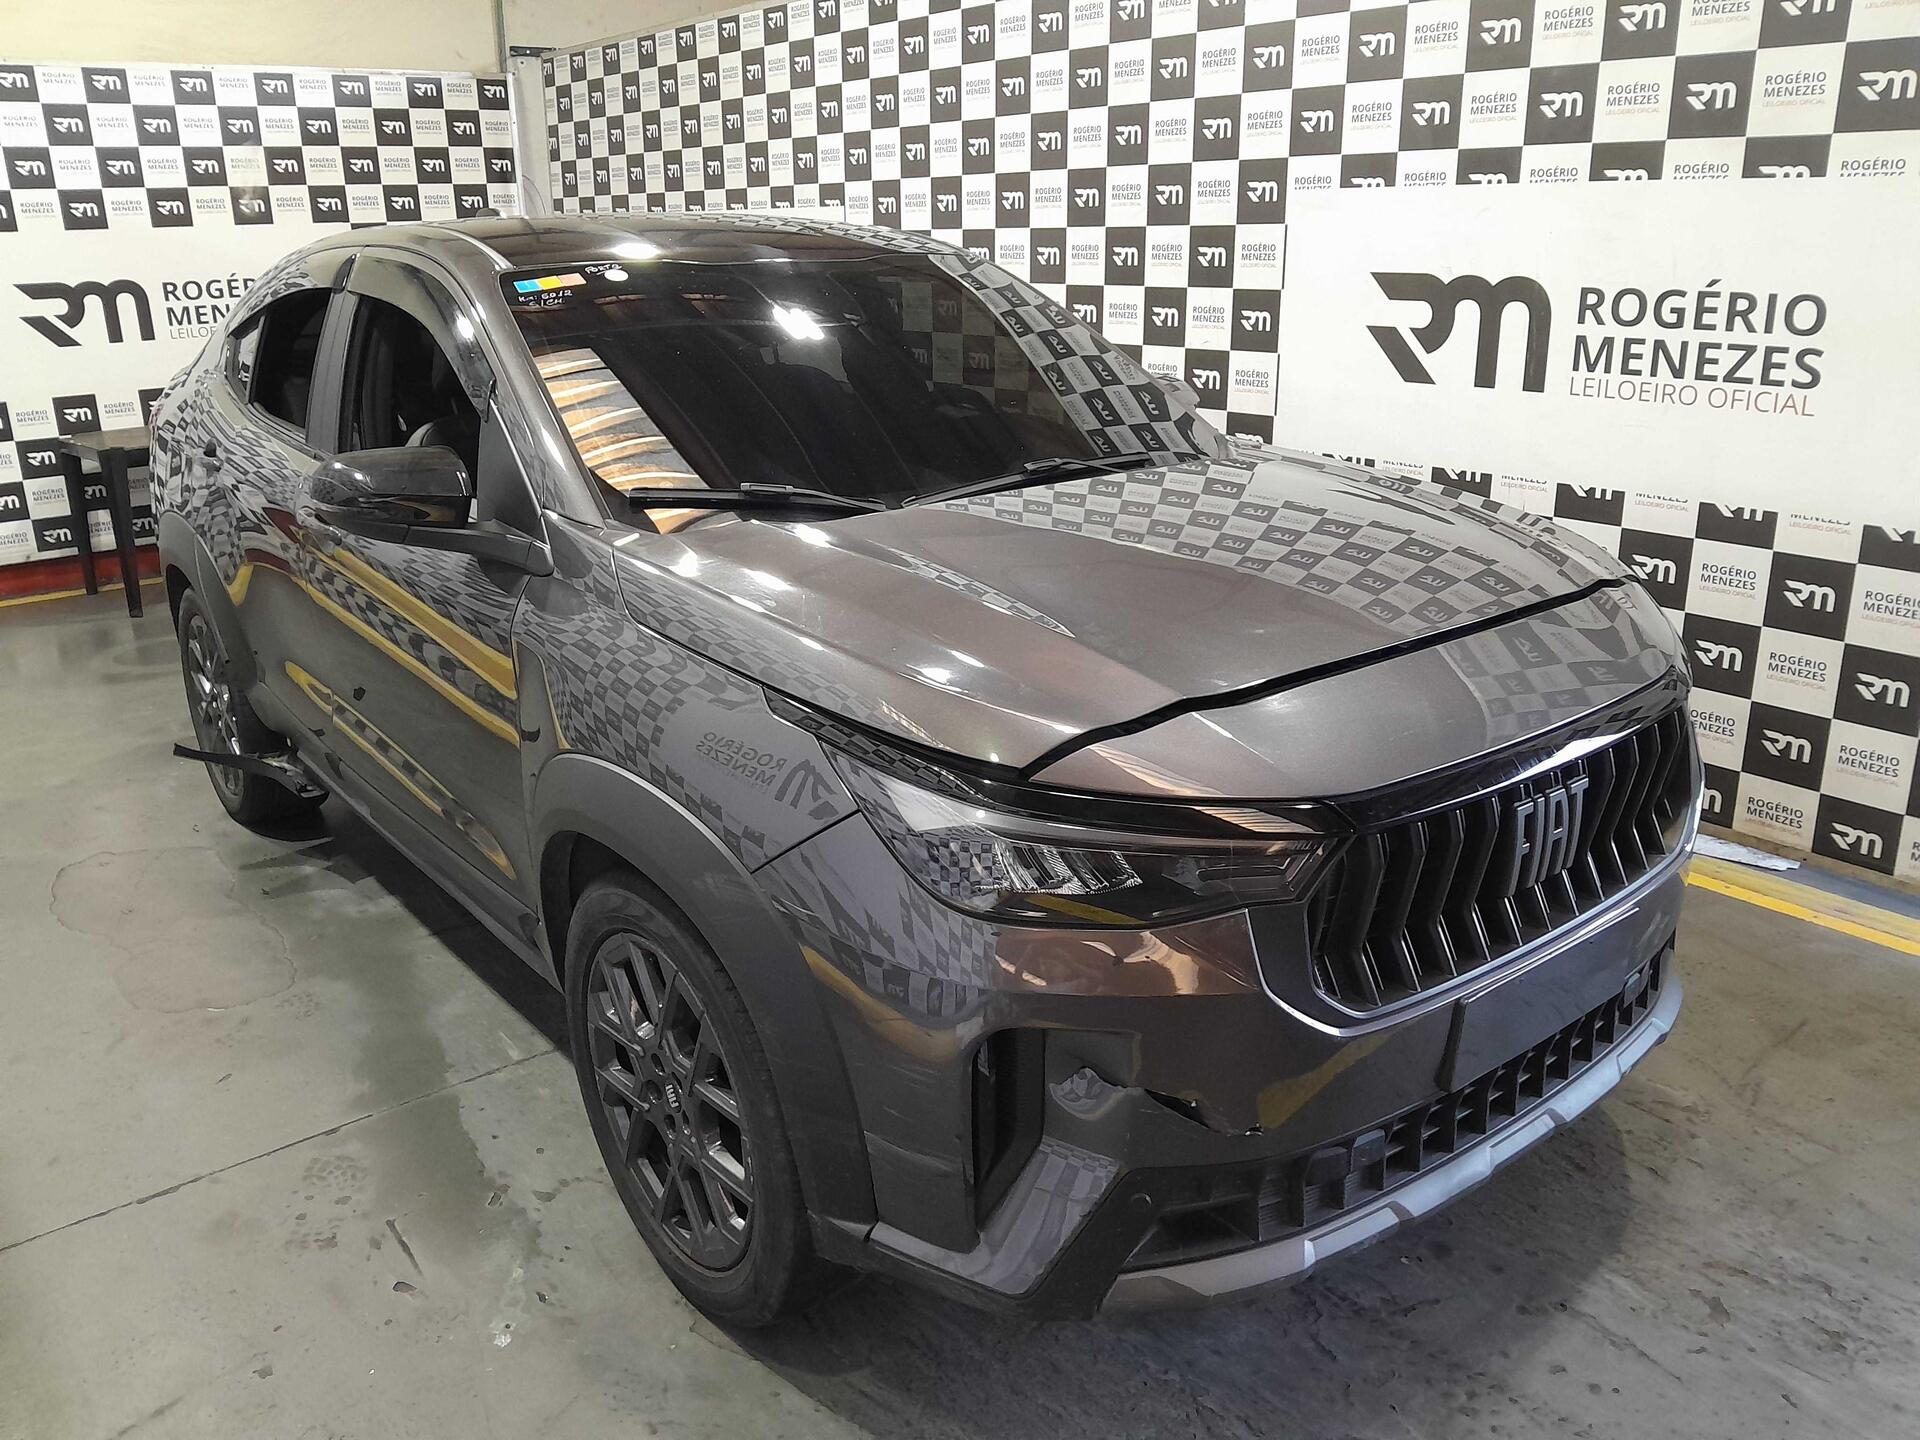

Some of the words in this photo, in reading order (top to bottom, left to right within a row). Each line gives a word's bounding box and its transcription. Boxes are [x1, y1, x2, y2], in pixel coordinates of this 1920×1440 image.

[1545, 6, 1593, 20] ROGÉRIO
[1691, 2, 1750, 17] MENEZES
[1415, 21, 1458, 34] ROGÉRIO
[1544, 17, 1593, 31] MENEZES
[1302, 35, 1340, 47] ROGÉRIO
[1415, 32, 1458, 45] MENEZES
[1302, 45, 1339, 56] MENEZES
[1766, 70, 1826, 85] ROGÉRIO
[1608, 82, 1660, 95] ROGÉRIO
[1764, 84, 1825, 98] MENEZES
[1472, 92, 1517, 104] ROGÉRIO
[1607, 94, 1659, 106] MENEZES
[1352, 102, 1392, 113] ROGÉRIO
[1471, 104, 1516, 115] MENEZES
[1352, 112, 1392, 122] MENEZES
[1674, 160, 1730, 174] ROGÉRIO
[1840, 157, 1906, 171] ROGÉRIO
[1404, 171, 1446, 182] ROGÉRIO
[1530, 167, 1578, 178] ROGÉRIO
[1294, 174, 1332, 185] ROGÉRIO
[1000, 244, 1024, 252] ROGÉRIO
[1072, 244, 1099, 252] ROGÉRIO
[1152, 244, 1182, 252] ROGÉRIO
[1242, 243, 1276, 252] ROGÉRIO
[1072, 252, 1099, 260] MENEZES
[1242, 253, 1276, 261] MENEZES
[1109, 302, 1137, 311] ROGÉRIO
[1193, 305, 1224, 314] ROGÉRIO
[1577, 279, 1827, 337] ROGÉRIO
[1109, 311, 1137, 319] MENEZES
[1193, 315, 1224, 323] MENEZES
[1147, 364, 1178, 373] ROGÉRIO
[1572, 335, 1824, 390] MENEZES
[1236, 369, 1268, 379] ROGÉRIO
[1235, 378, 1268, 388] MENEZES
[1569, 376, 1698, 406] LEILOEIRO
[1706, 387, 1815, 417] OFICIAL
[1702, 562, 1756, 580] ROGÉRIO
[1700, 573, 1756, 591] MENEZES
[1864, 602, 1920, 620] MENEZE
[1770, 652, 1827, 671] ROGÉRIO
[1768, 663, 1826, 683] MENEZES
[1690, 710, 1736, 726] OGÉRIO
[1692, 721, 1735, 737] ENEZES
[1840, 745, 1900, 766] ROGÉRIO
[1838, 756, 1898, 778] MENEZES
[1748, 796, 1803, 818] ROGÉRIO
[1746, 806, 1802, 829] MENEZES
[1508, 775, 1589, 897] FIAT
